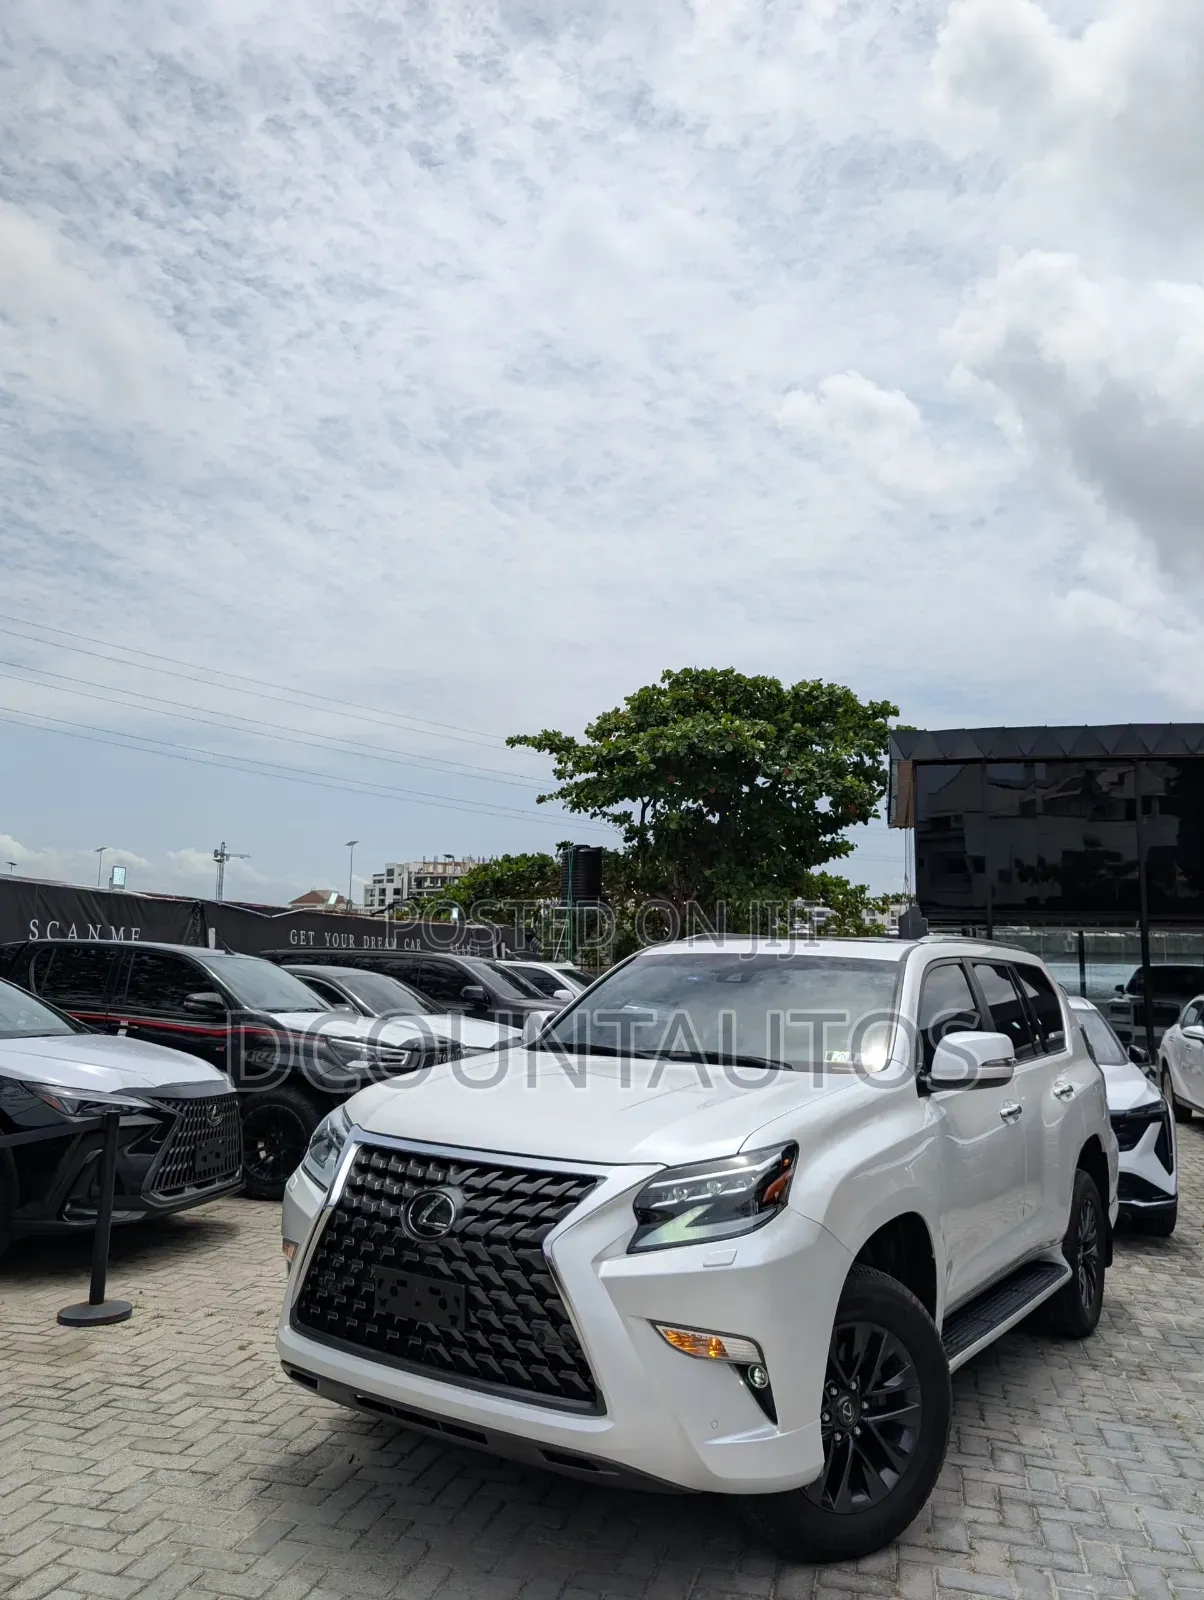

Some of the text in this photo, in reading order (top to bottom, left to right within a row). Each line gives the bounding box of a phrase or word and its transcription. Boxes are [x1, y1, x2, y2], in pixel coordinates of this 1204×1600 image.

[28, 919, 102, 941] SCAN
[290, 929, 421, 951] GET YOUR DREAM CAR
